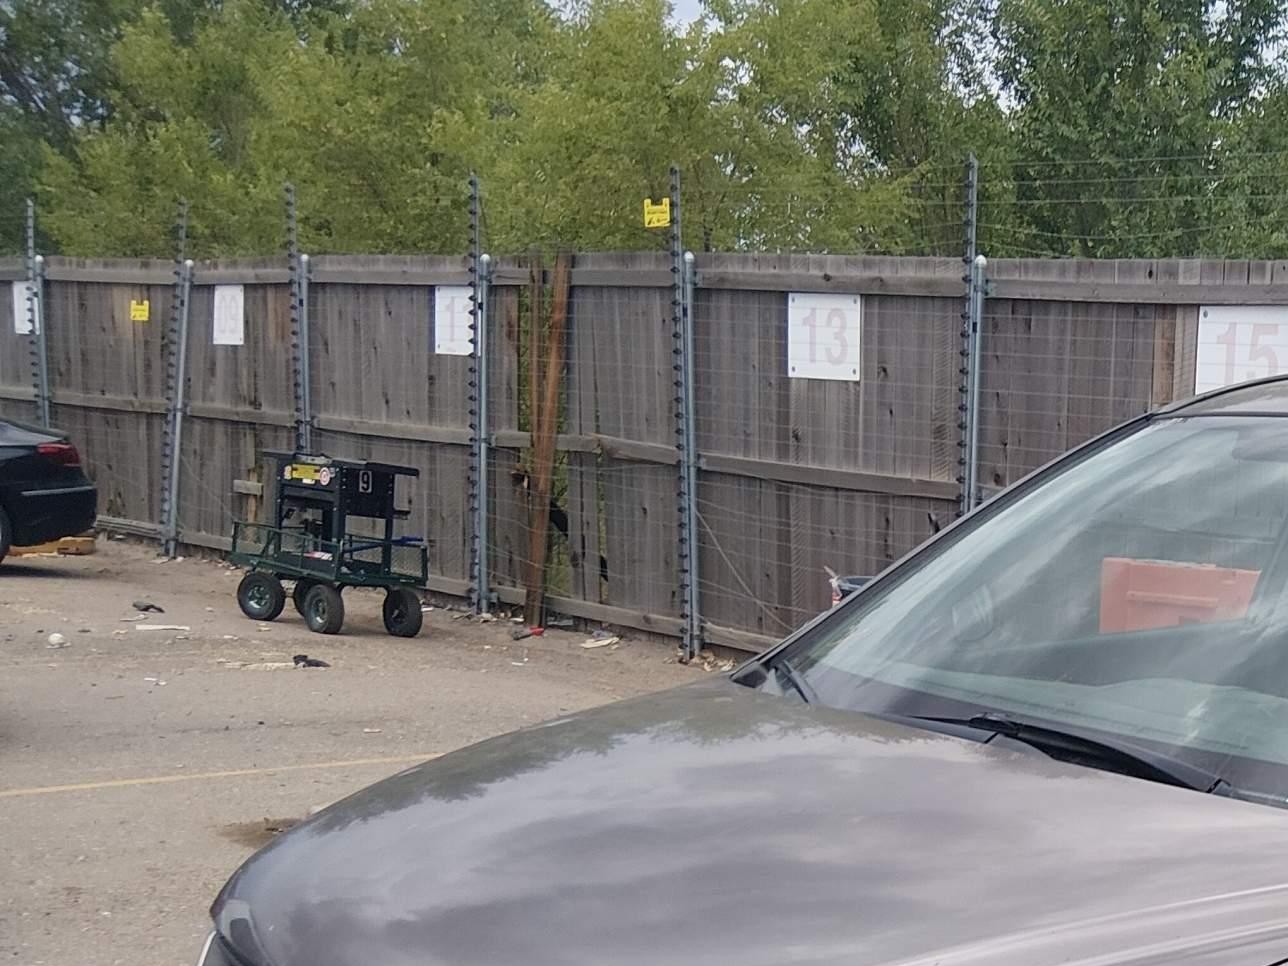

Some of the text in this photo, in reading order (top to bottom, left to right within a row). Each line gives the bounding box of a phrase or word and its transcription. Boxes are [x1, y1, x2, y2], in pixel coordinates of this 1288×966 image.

[801, 308, 848, 365] 13
[1216, 322, 1279, 384] 15
[361, 471, 372, 491] 9
